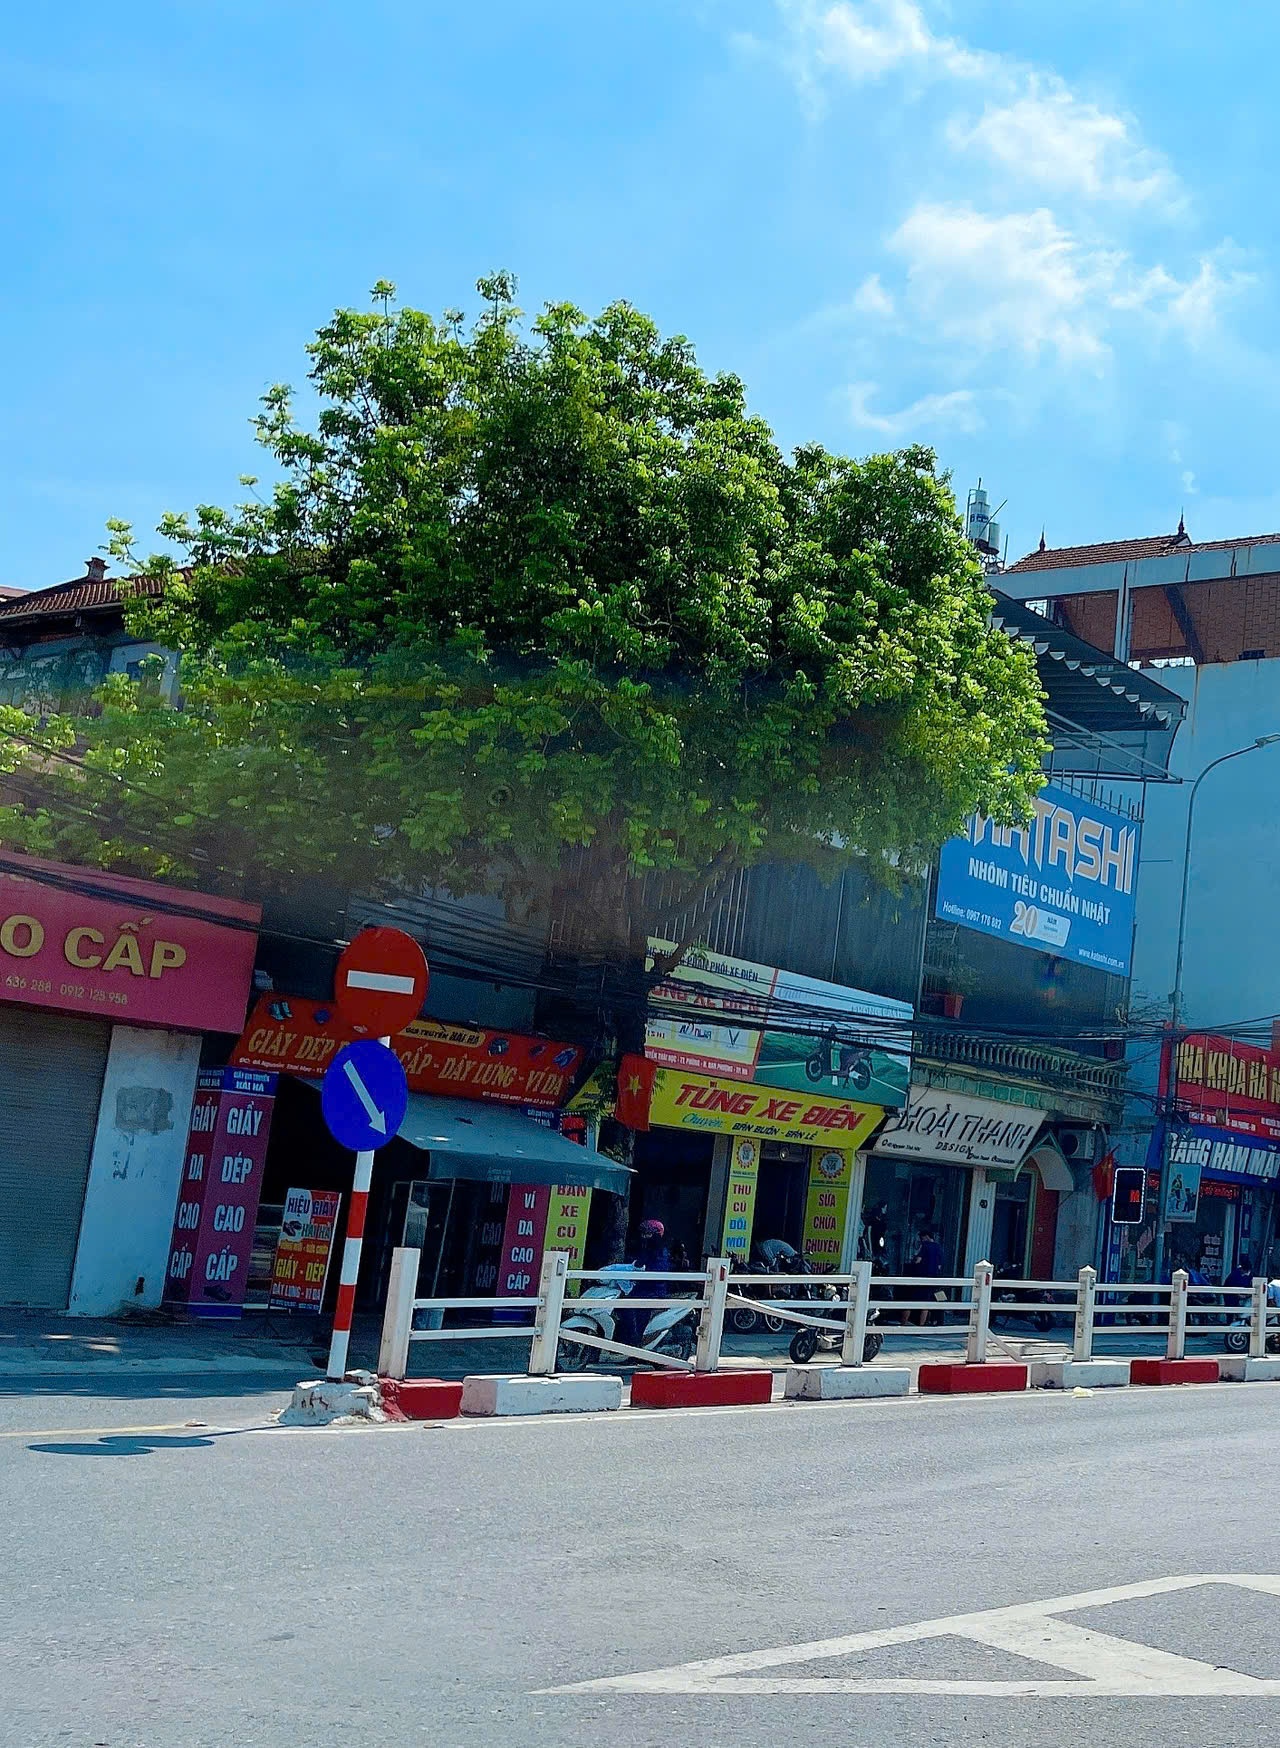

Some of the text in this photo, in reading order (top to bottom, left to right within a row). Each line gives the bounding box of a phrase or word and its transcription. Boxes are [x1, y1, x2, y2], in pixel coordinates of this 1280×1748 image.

[968, 857, 1111, 928] NHÔM TIÊU CHUẨN NHẬT
[1009, 899, 1039, 939] 20
[64, 917, 187, 979] CẤP
[1206, 1050, 1247, 1095] KHOA
[1249, 1055, 1268, 1101] HÀ
[756, 1098, 804, 1122] XE
[800, 1104, 867, 1133] ĐIỆN
[731, 1122, 752, 1133] BÁN
[753, 1125, 781, 1138] BUÔN
[935, 1141, 974, 1155] DESIGN
[1209, 1136, 1251, 1174] HÀM
[188, 1153, 204, 1181] DA
[221, 1151, 253, 1185] DÉP
[523, 1190, 537, 1210] VÍ
[732, 1183, 752, 1196] THU
[818, 1189, 836, 1208] SỬA
[178, 1202, 200, 1230] CAO
[213, 1204, 246, 1233] CAO
[287, 1194, 312, 1217] HIỆU
[560, 1205, 579, 1218] XE
[517, 1219, 534, 1237] DA
[170, 1242, 193, 1280] CẤP
[205, 1245, 239, 1282] CẤP
[511, 1246, 535, 1264] CAO
[506, 1269, 531, 1291] CẤP
